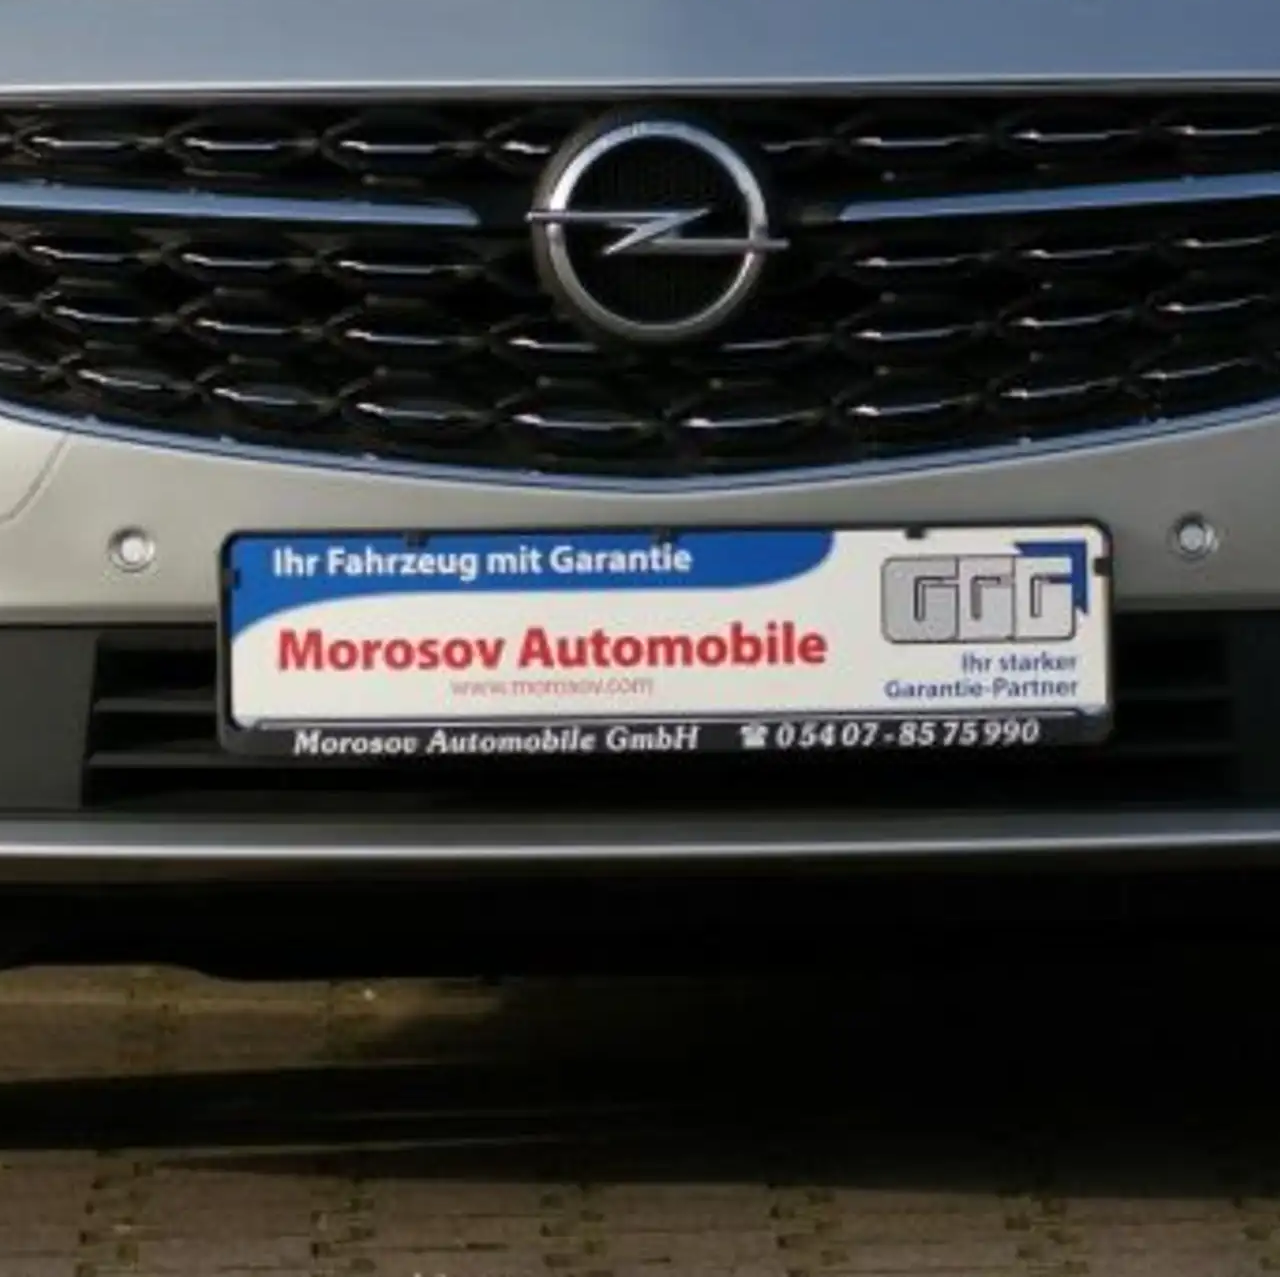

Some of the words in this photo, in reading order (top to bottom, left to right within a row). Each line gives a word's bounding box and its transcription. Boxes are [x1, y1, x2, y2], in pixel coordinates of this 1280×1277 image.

[273, 547, 318, 576] Ihr
[327, 546, 479, 582] Fahrzeug
[487, 545, 541, 574] mit
[549, 542, 693, 573] Garantie
[278, 628, 505, 671] Morosov
[519, 621, 828, 670] Automobile
[961, 652, 992, 673] Ihr
[998, 650, 1078, 673] starker
[451, 676, 655, 698] www.morosov.com
[884, 678, 1078, 700] Garantie-Partner
[293, 728, 419, 756] Morosov
[426, 725, 598, 755] Automobile
[605, 724, 700, 752] GmbH
